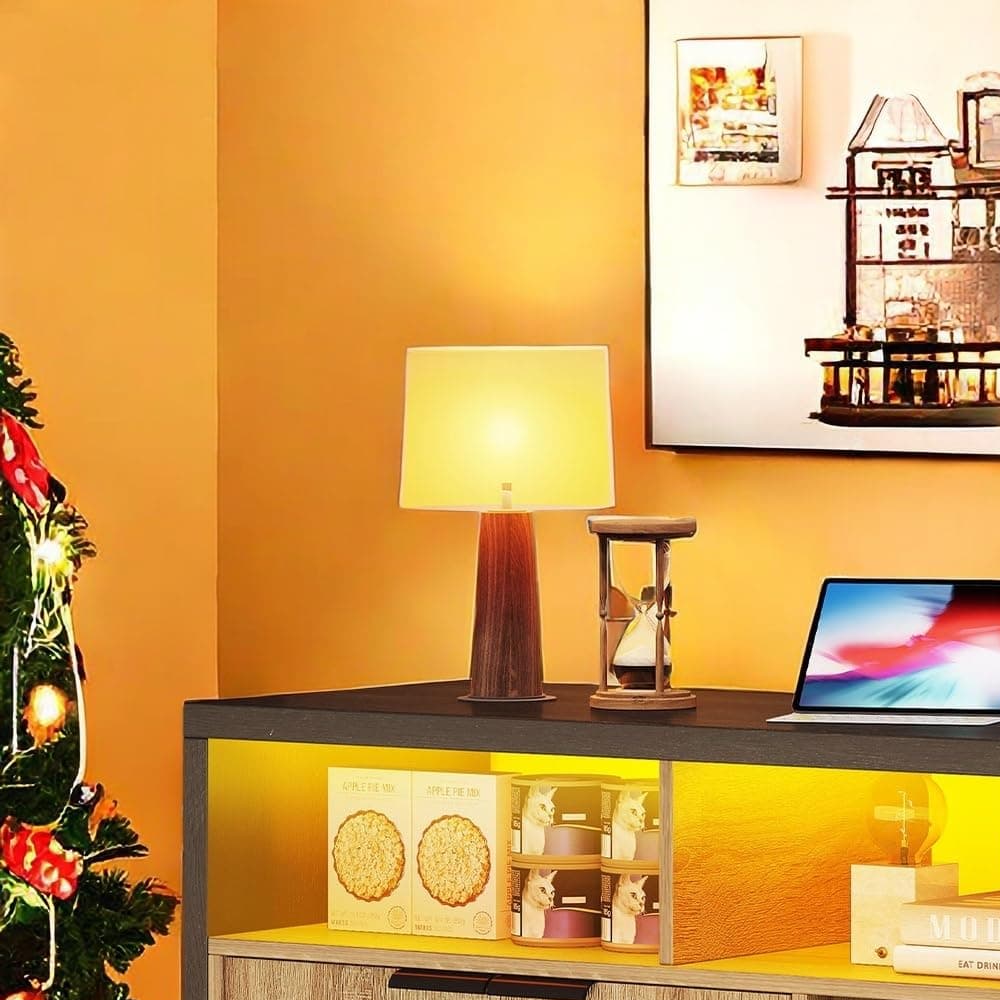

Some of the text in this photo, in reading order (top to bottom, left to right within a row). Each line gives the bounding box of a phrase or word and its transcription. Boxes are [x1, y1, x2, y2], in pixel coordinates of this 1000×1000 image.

[342, 781, 395, 793] APPLE PIE MIX
[426, 785, 480, 798] APPLE PIE MIX
[958, 960, 975, 969] EAT
